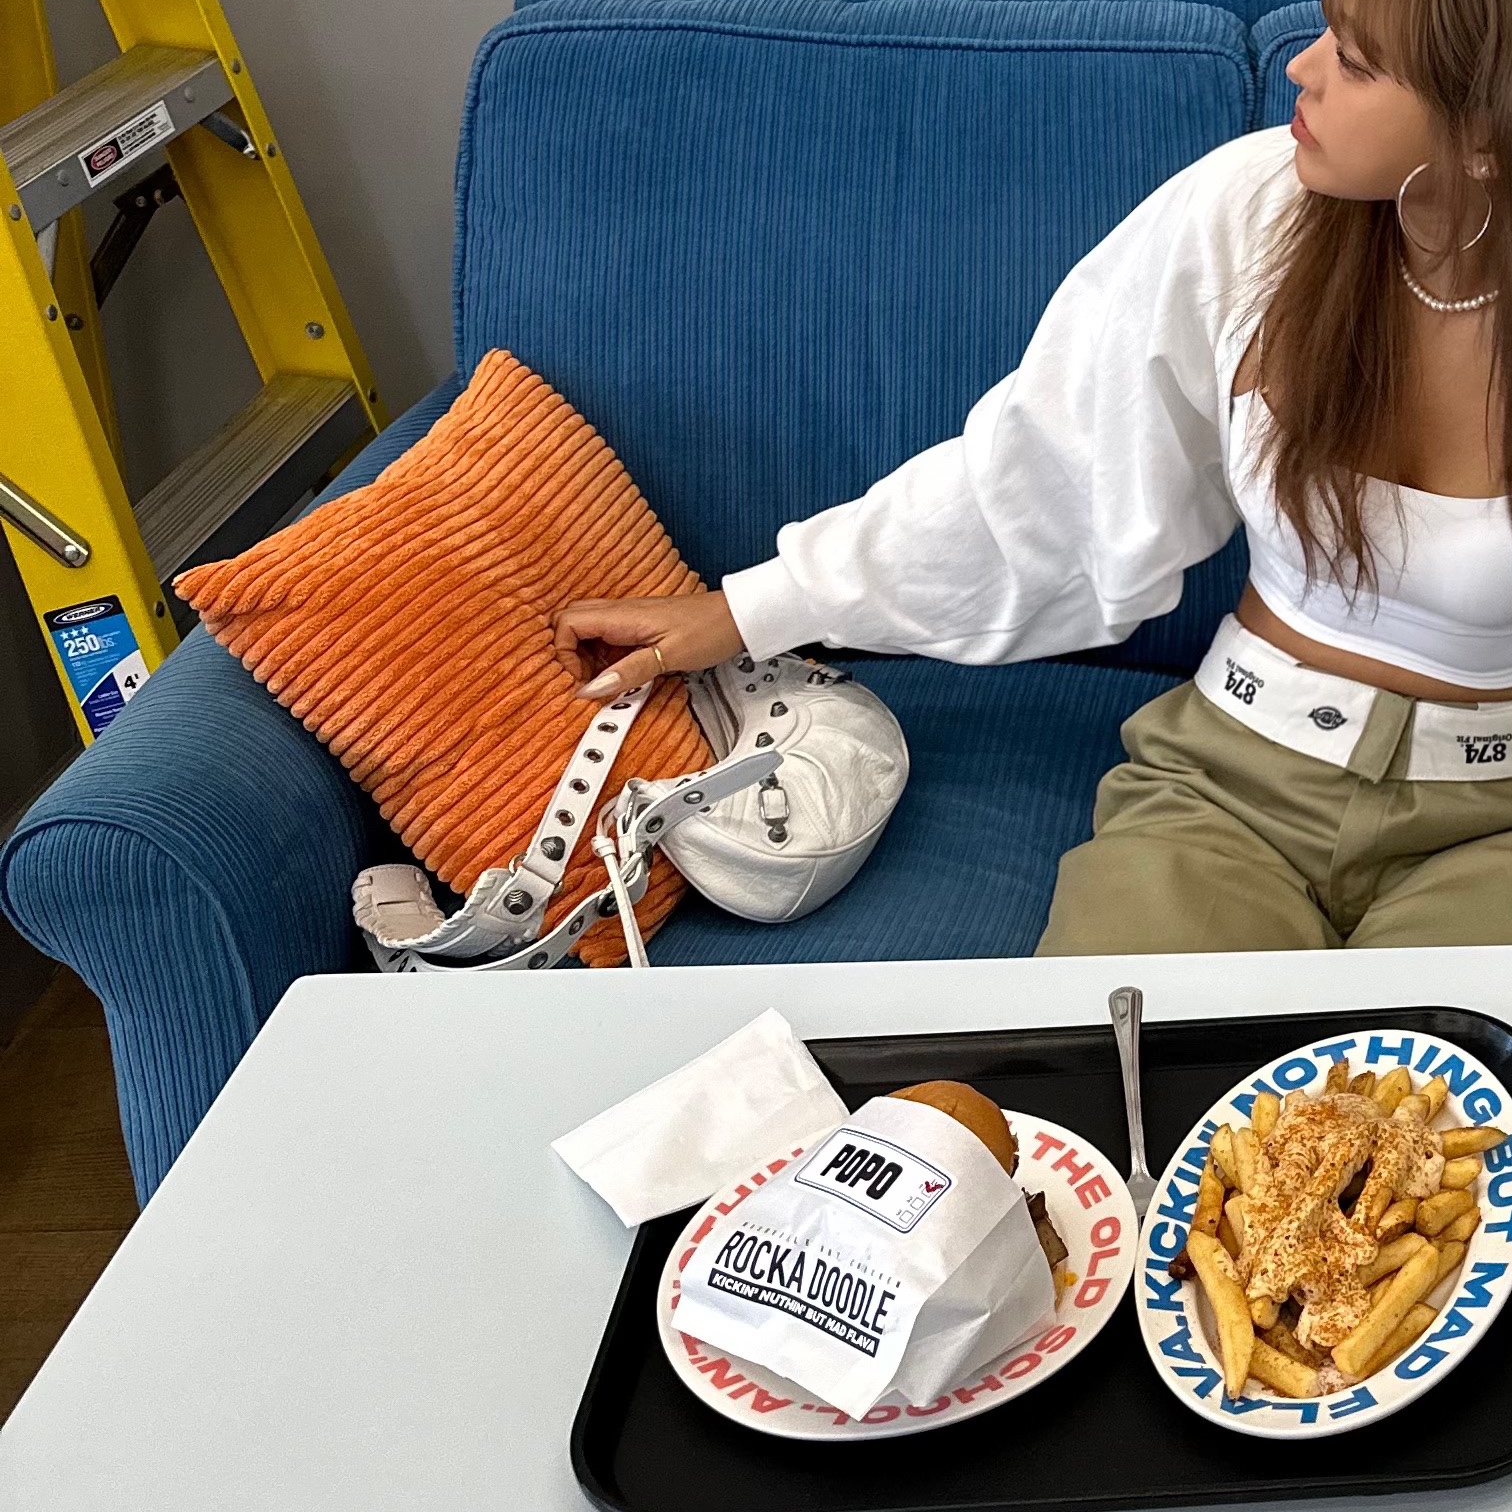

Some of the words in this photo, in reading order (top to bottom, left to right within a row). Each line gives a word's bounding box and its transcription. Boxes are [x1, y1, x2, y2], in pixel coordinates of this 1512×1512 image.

[64, 634, 99, 658] 250
[1224, 670, 1256, 706] 874
[1456, 735, 1471, 744] Fit
[1465, 743, 1507, 764] 874
[1473, 733, 1512, 745] Original
[820, 1143, 903, 1200] POPO
[1031, 1131, 1112, 1210] THE
[1074, 1216, 1121, 1308] OLD
[1145, 1119, 1219, 1312] KICKIN'
[1230, 1036, 1502, 1127] NOTHING
[1395, 1262, 1509, 1380] MAD
[715, 1230, 805, 1293] ROCKA
[807, 1258, 896, 1335] DOODLE
[711, 1273, 759, 1297] KICKIN'
[758, 1291, 807, 1315] NUTHIN'
[804, 1307, 828, 1326] BUT
[825, 1318, 849, 1336] MAD
[845, 1328, 877, 1354] FLAVA
